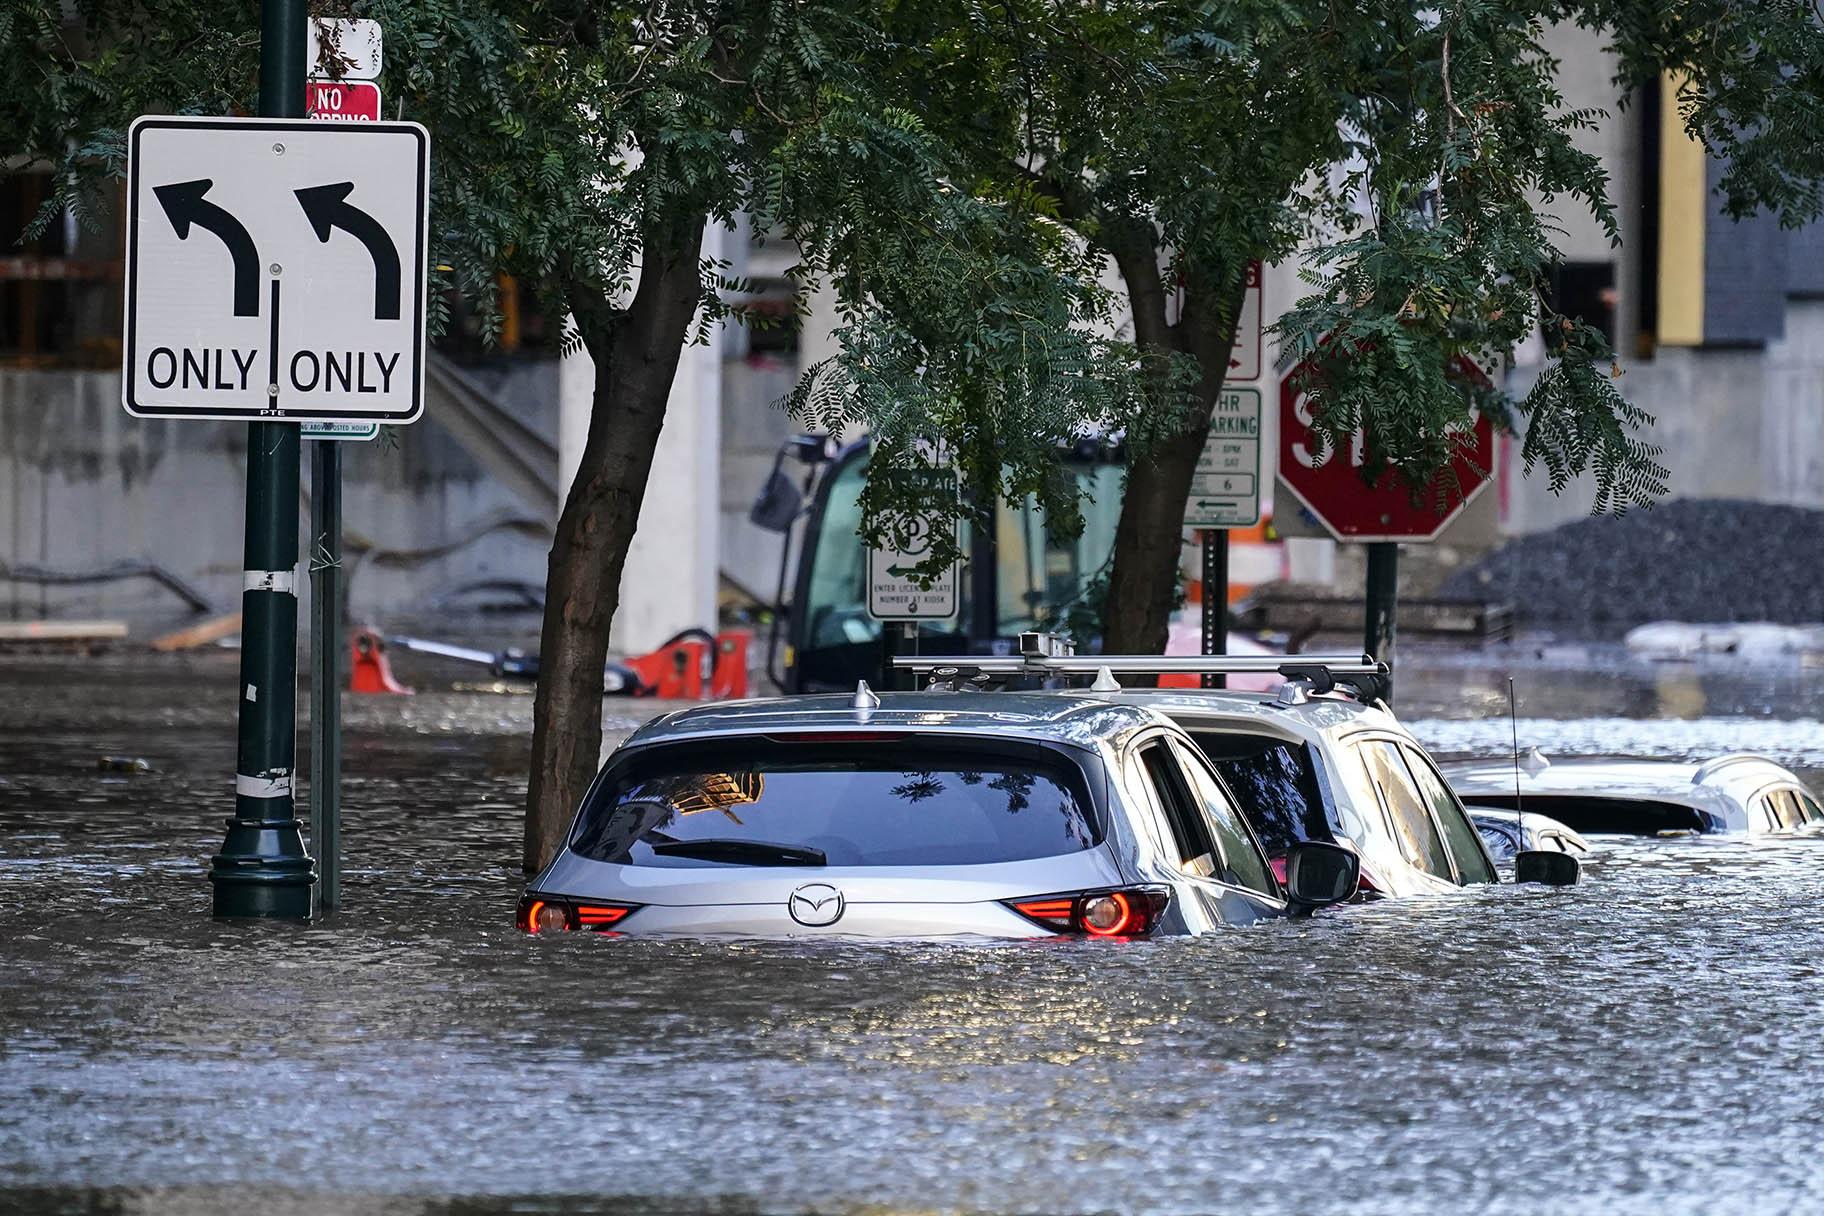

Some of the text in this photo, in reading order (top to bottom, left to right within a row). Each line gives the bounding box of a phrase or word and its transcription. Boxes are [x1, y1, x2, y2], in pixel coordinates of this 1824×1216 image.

[317, 88, 342, 110] NO
[147, 347, 258, 390] ONLY
[290, 350, 401, 393] ONLY
[1218, 395, 1240, 412] HR
[1209, 416, 1257, 434] ARKING
